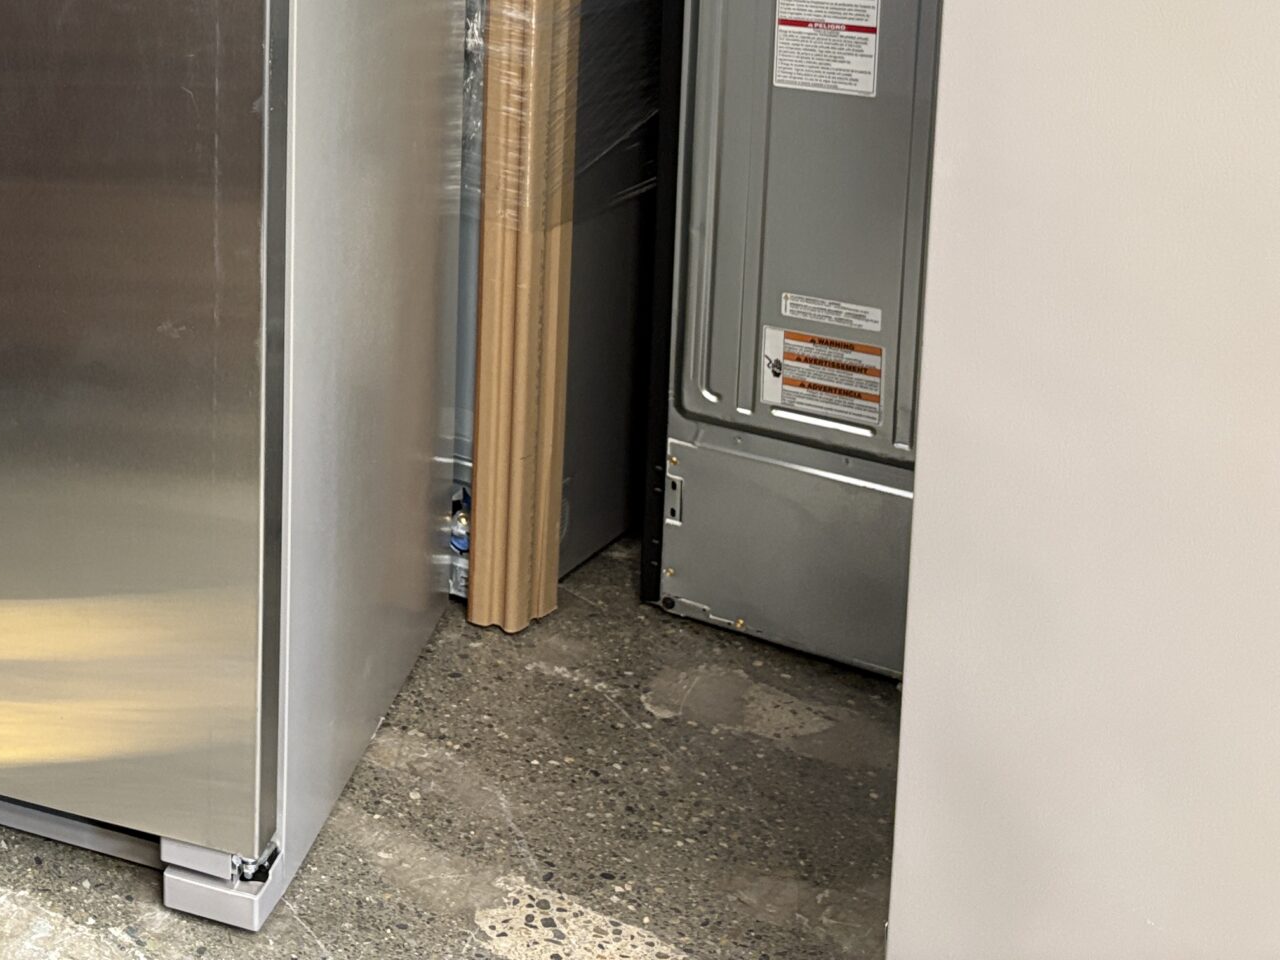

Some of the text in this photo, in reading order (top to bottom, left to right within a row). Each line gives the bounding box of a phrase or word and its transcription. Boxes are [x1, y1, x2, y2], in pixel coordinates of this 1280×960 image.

[814, 22, 846, 30] PELIGRO
[817, 337, 855, 351] WARNING
[804, 356, 869, 374] AVERTISSEMENT
[807, 381, 862, 399] ADVERTENCIA
